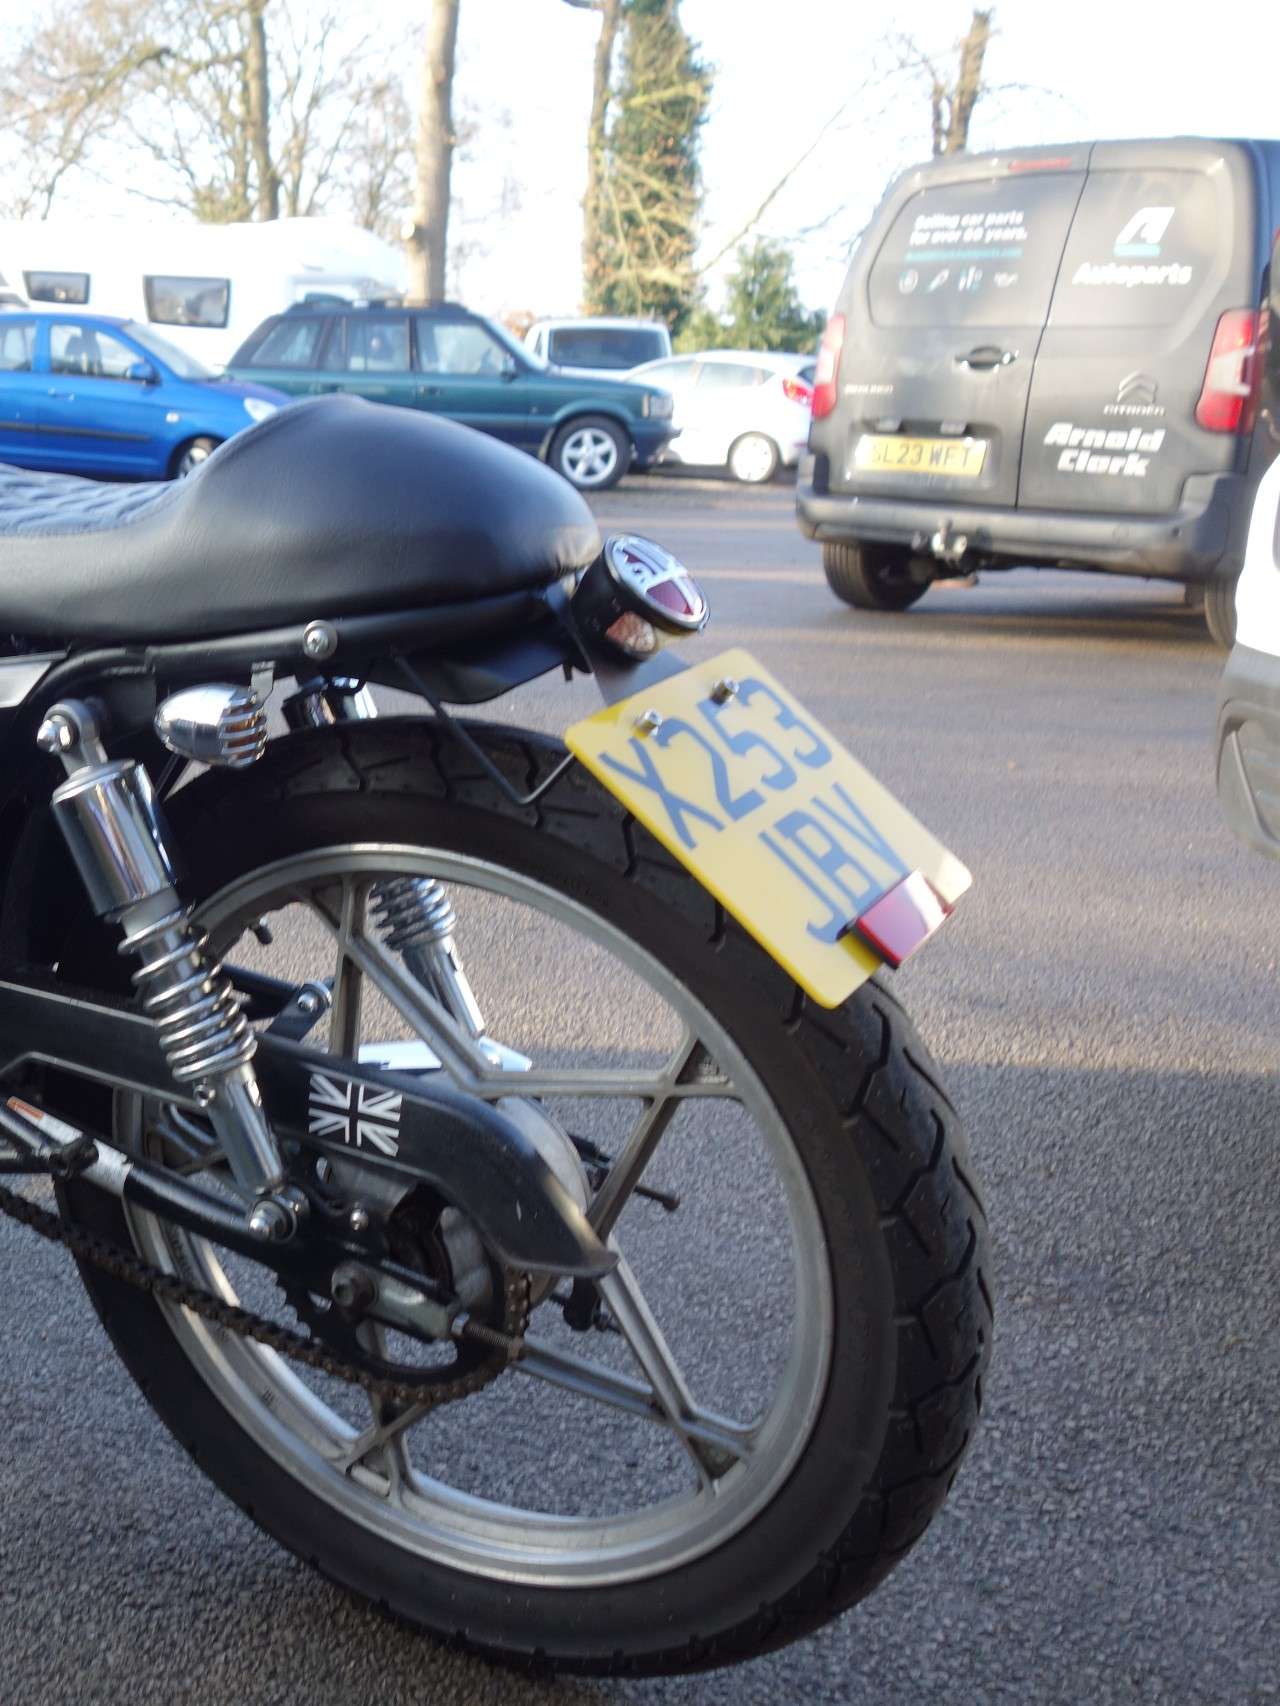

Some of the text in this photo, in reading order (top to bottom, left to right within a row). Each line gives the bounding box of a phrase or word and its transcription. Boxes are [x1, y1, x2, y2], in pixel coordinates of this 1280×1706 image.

[960, 213, 984, 226] car
[984, 210, 1024, 229] parts
[1072, 261, 1193, 288] Autoparts
[1043, 421, 1166, 453] Arnold
[1057, 448, 1151, 476] Clark
[598, 678, 832, 849] X253
[758, 782, 910, 944] JBV
